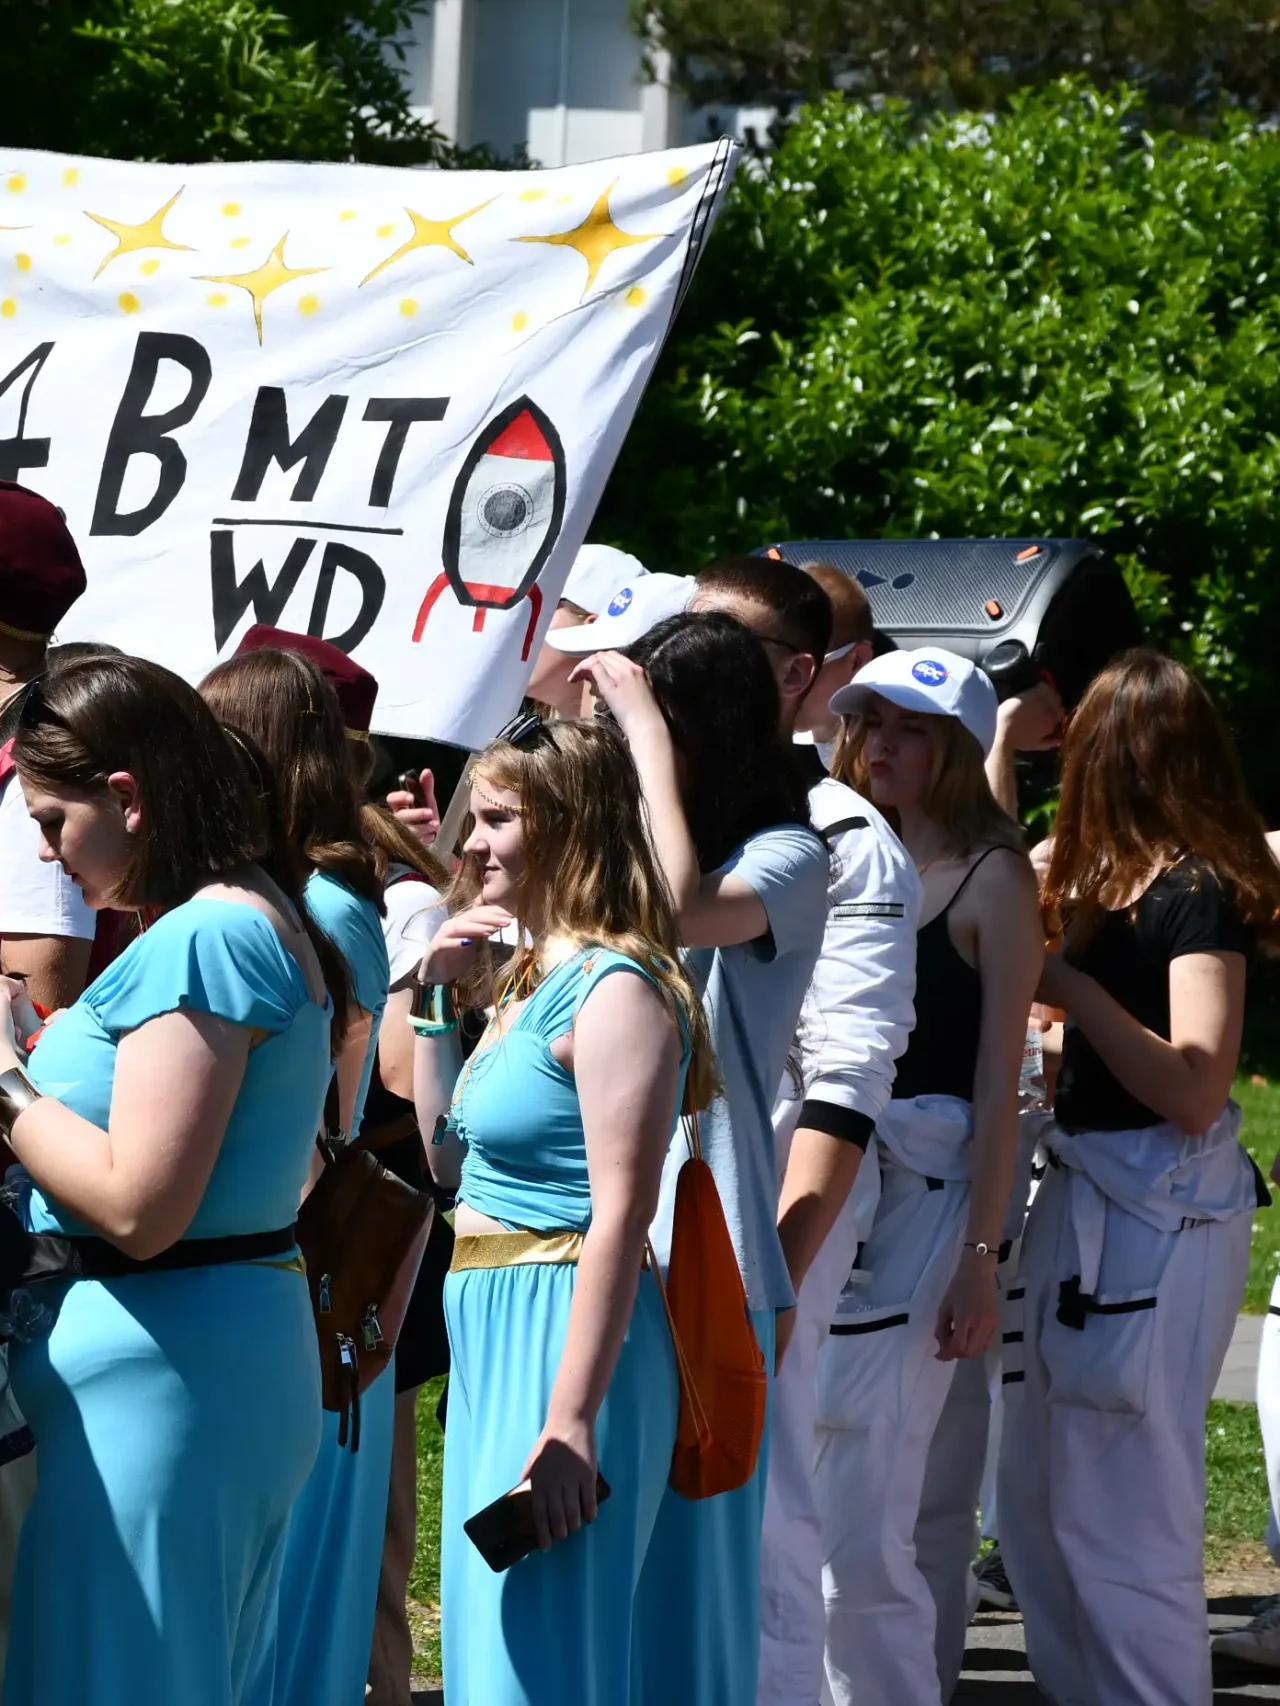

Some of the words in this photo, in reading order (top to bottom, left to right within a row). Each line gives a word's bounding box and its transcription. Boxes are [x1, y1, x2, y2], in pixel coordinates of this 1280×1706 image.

[89, 331, 212, 536] B
[230, 385, 450, 508] MT
[210, 530, 386, 655] WD
